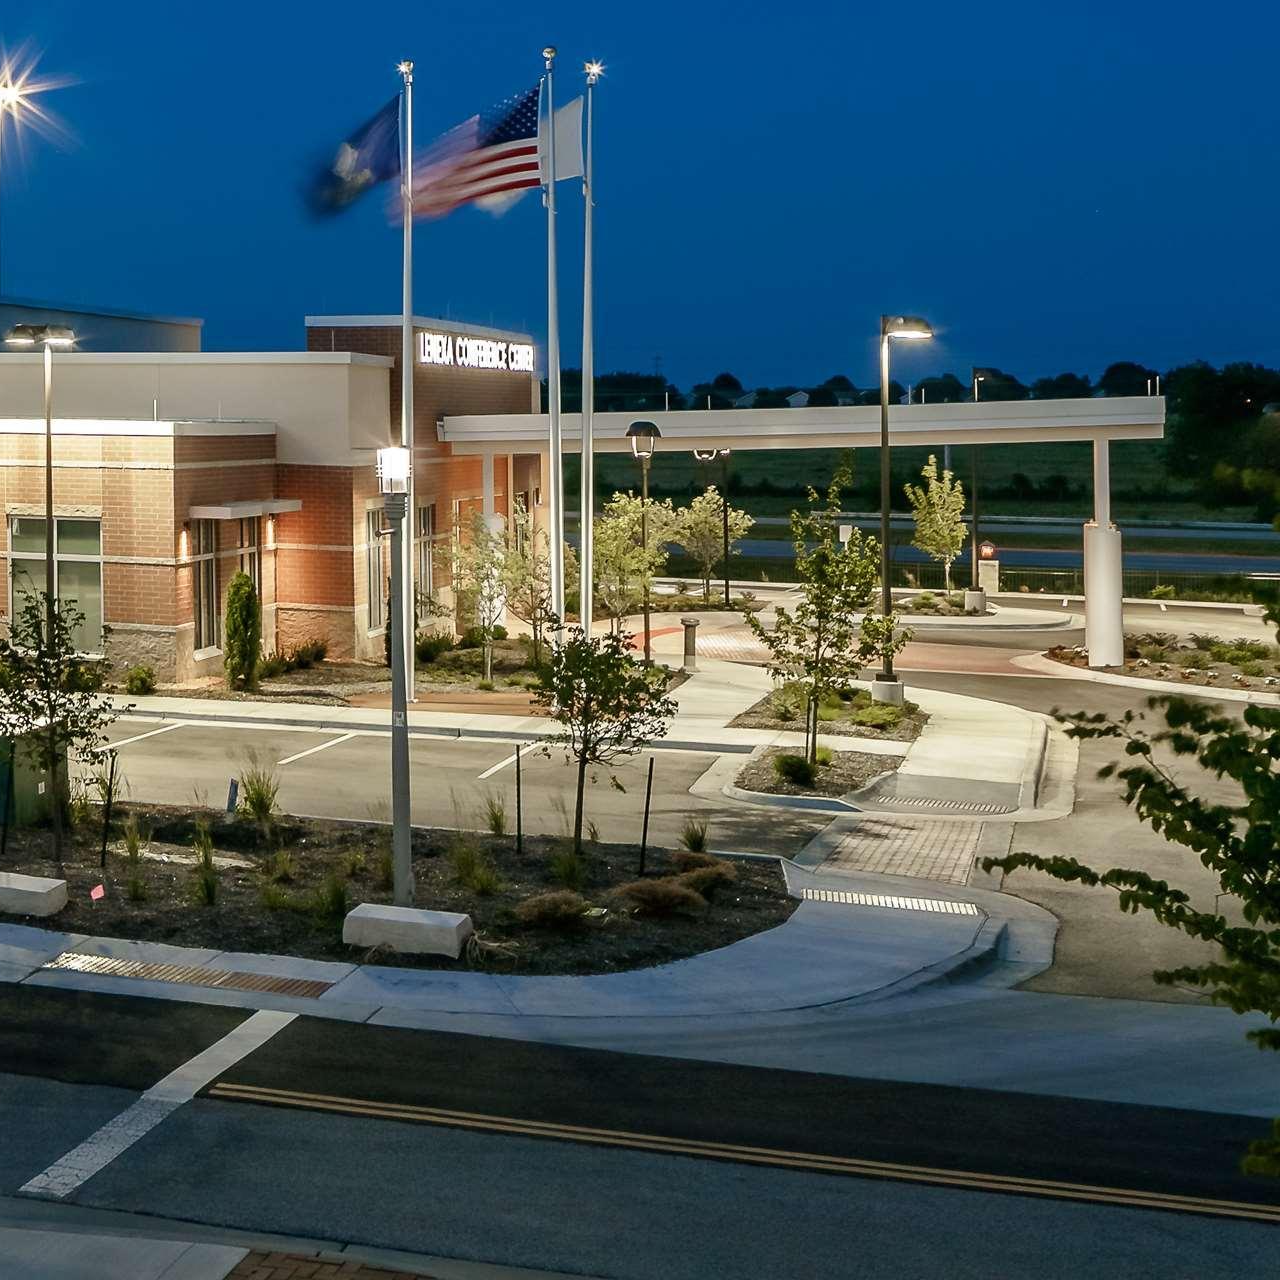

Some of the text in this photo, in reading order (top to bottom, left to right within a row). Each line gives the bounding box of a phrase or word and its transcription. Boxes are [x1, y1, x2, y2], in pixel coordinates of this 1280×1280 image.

[420, 331, 534, 372] LENEXA CONFERENCE CENTER
